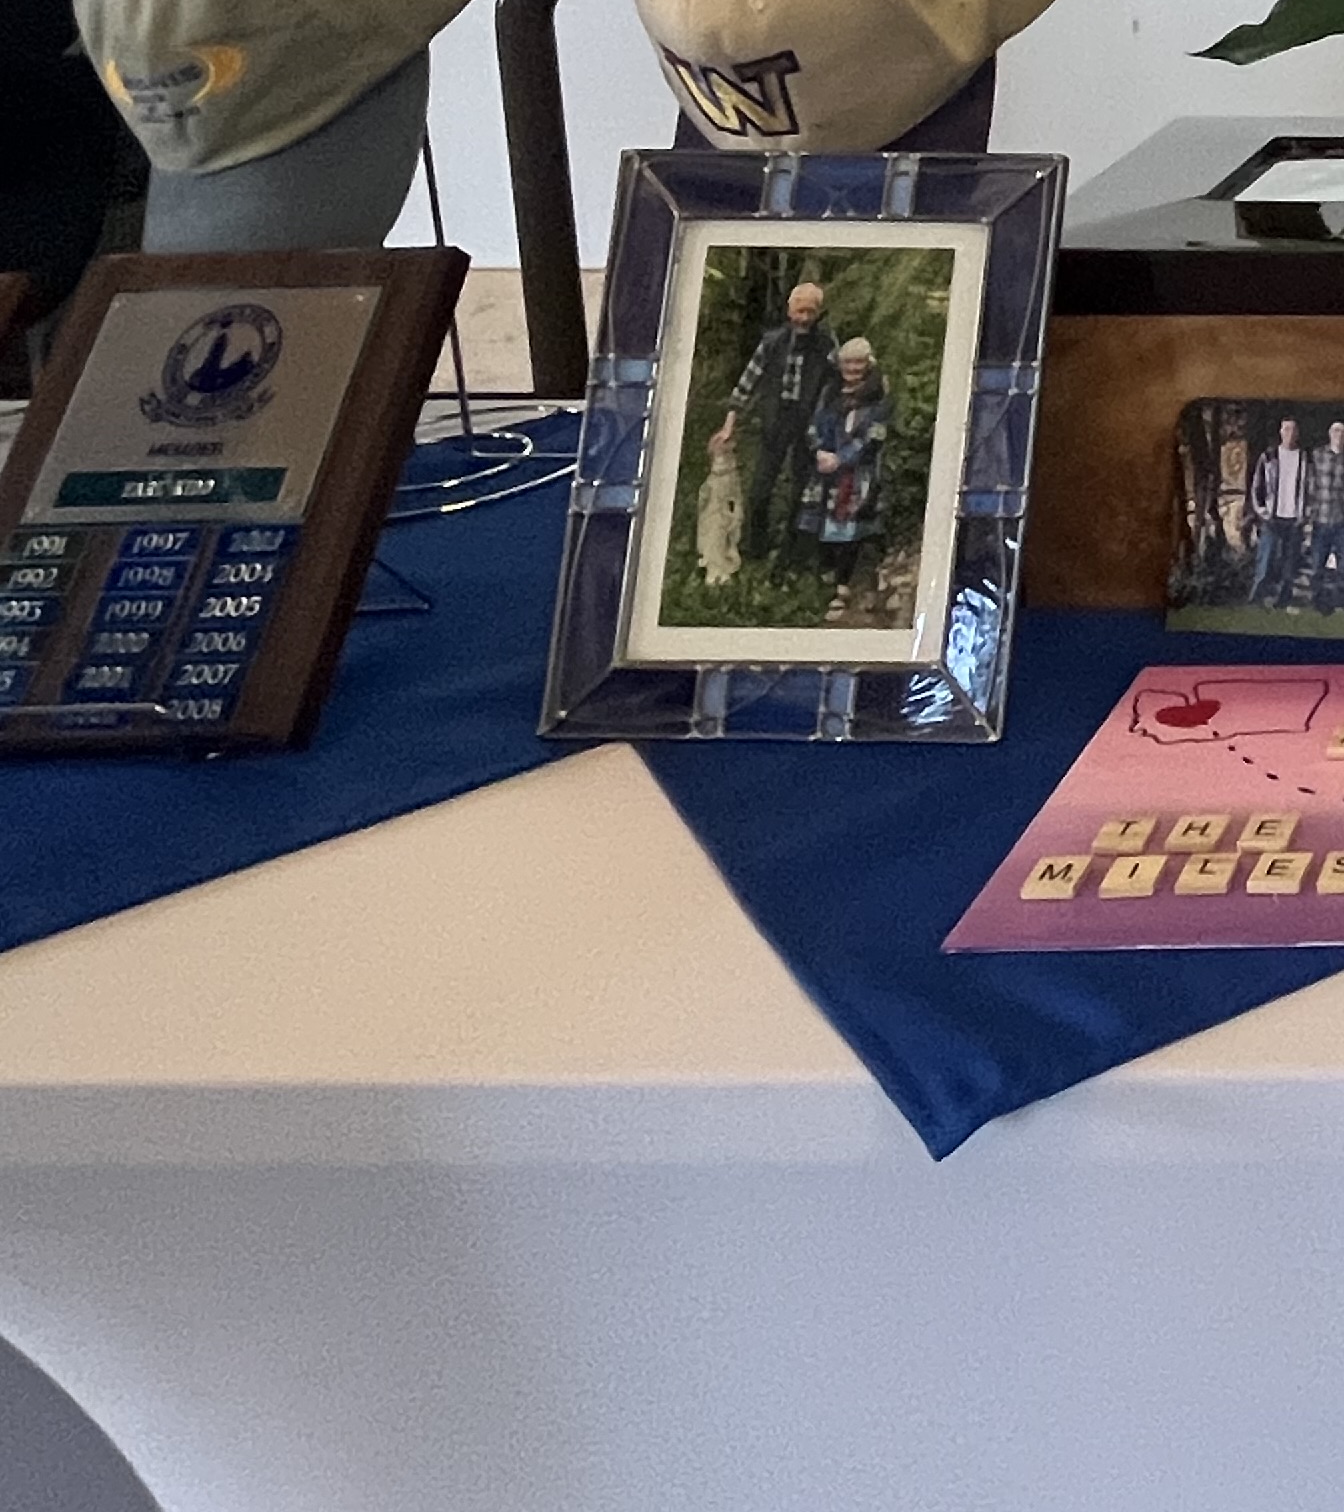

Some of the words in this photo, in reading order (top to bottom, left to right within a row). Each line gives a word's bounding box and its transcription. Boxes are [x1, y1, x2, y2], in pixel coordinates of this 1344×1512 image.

[658, 42, 801, 137] W
[132, 531, 190, 554] 1997
[7, 568, 58, 589] 1992
[118, 565, 176, 587] 1998
[0, 600, 45, 621] 993
[104, 600, 163, 621] 1999
[199, 596, 262, 618] 2005
[185, 631, 246, 653] 2006
[175, 664, 240, 686] 2007
[166, 699, 223, 720] 2008
